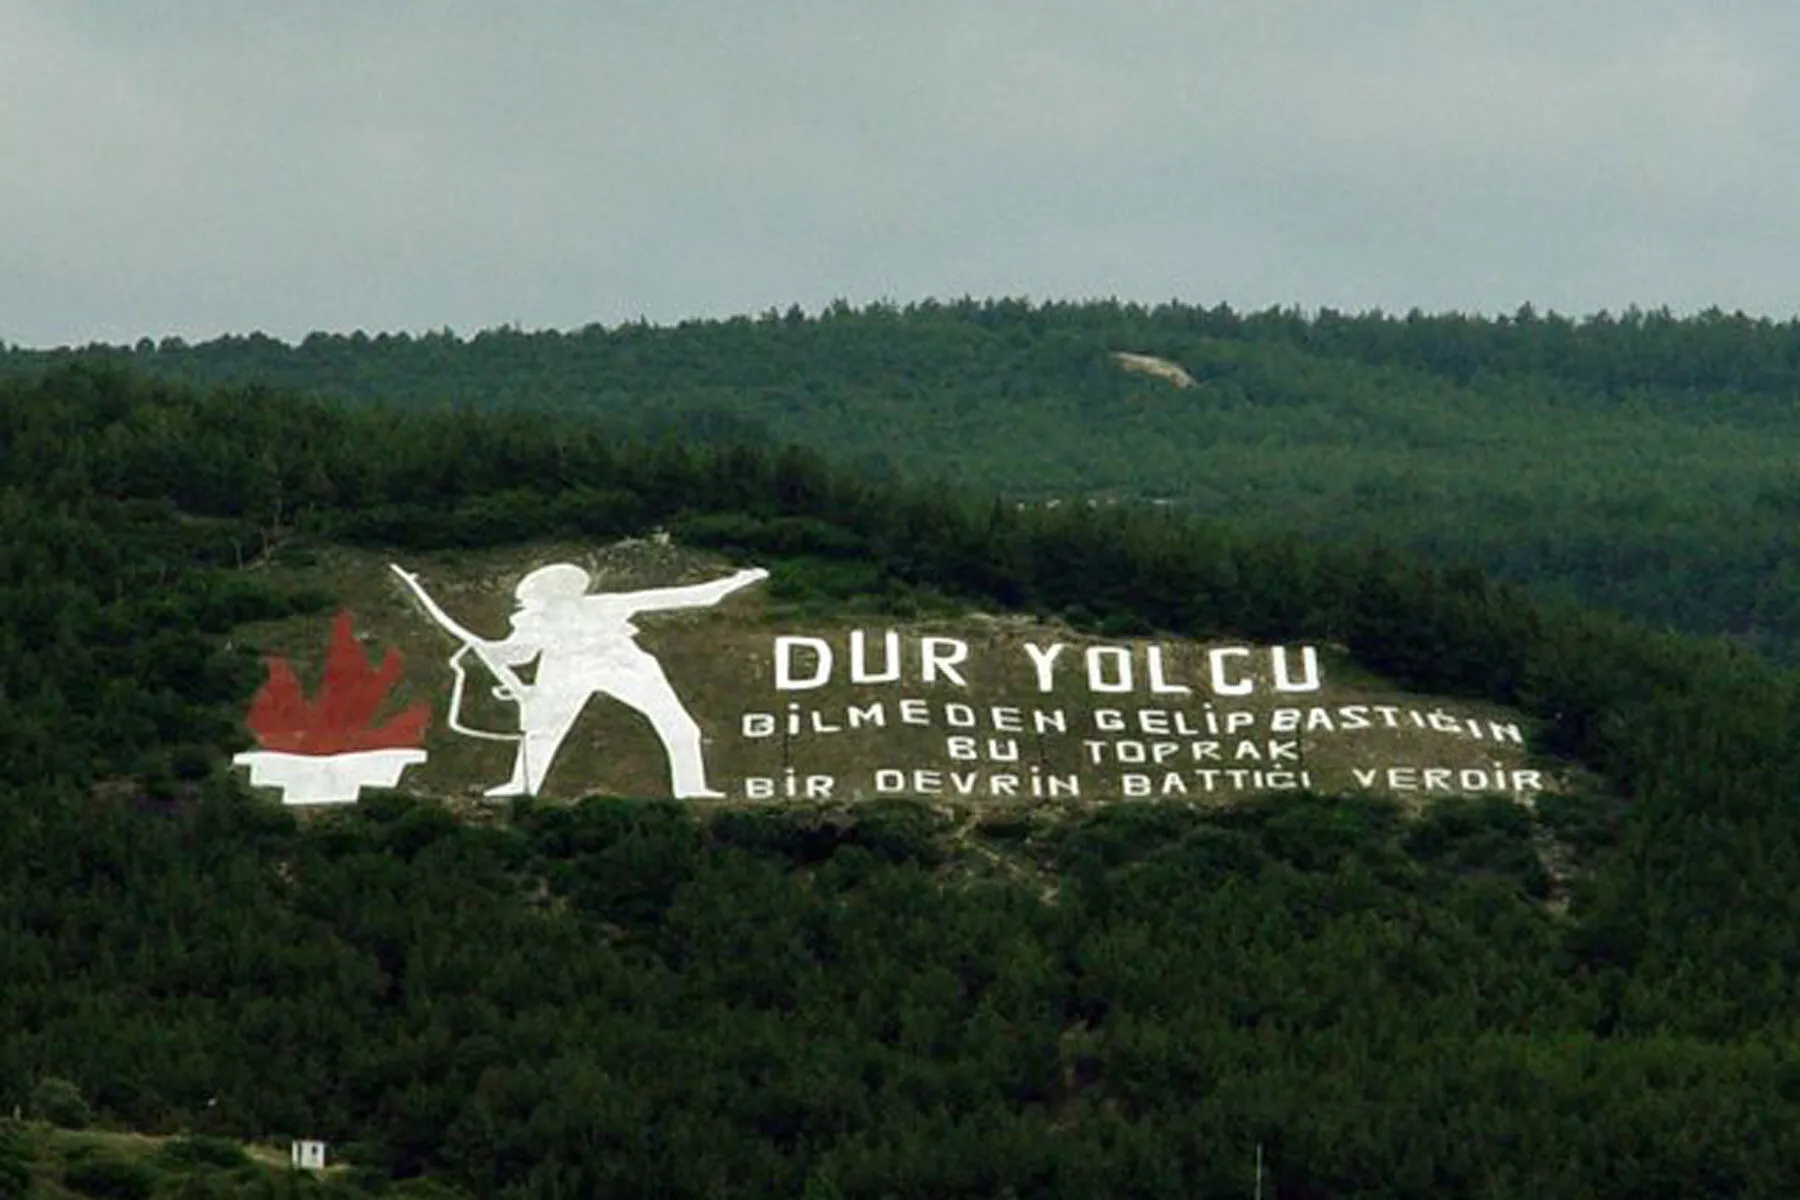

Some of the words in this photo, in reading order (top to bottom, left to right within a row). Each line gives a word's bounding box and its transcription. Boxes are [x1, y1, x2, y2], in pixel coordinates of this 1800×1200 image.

[773, 628, 970, 693] DUR
[1022, 643, 1321, 697] YOLCU
[741, 698, 1067, 738] BİLMEDEN
[1093, 701, 1255, 736] GELİP
[945, 735, 1019, 763] BU
[1082, 739, 1299, 764] TOPRAK
[744, 766, 836, 800] BİR
